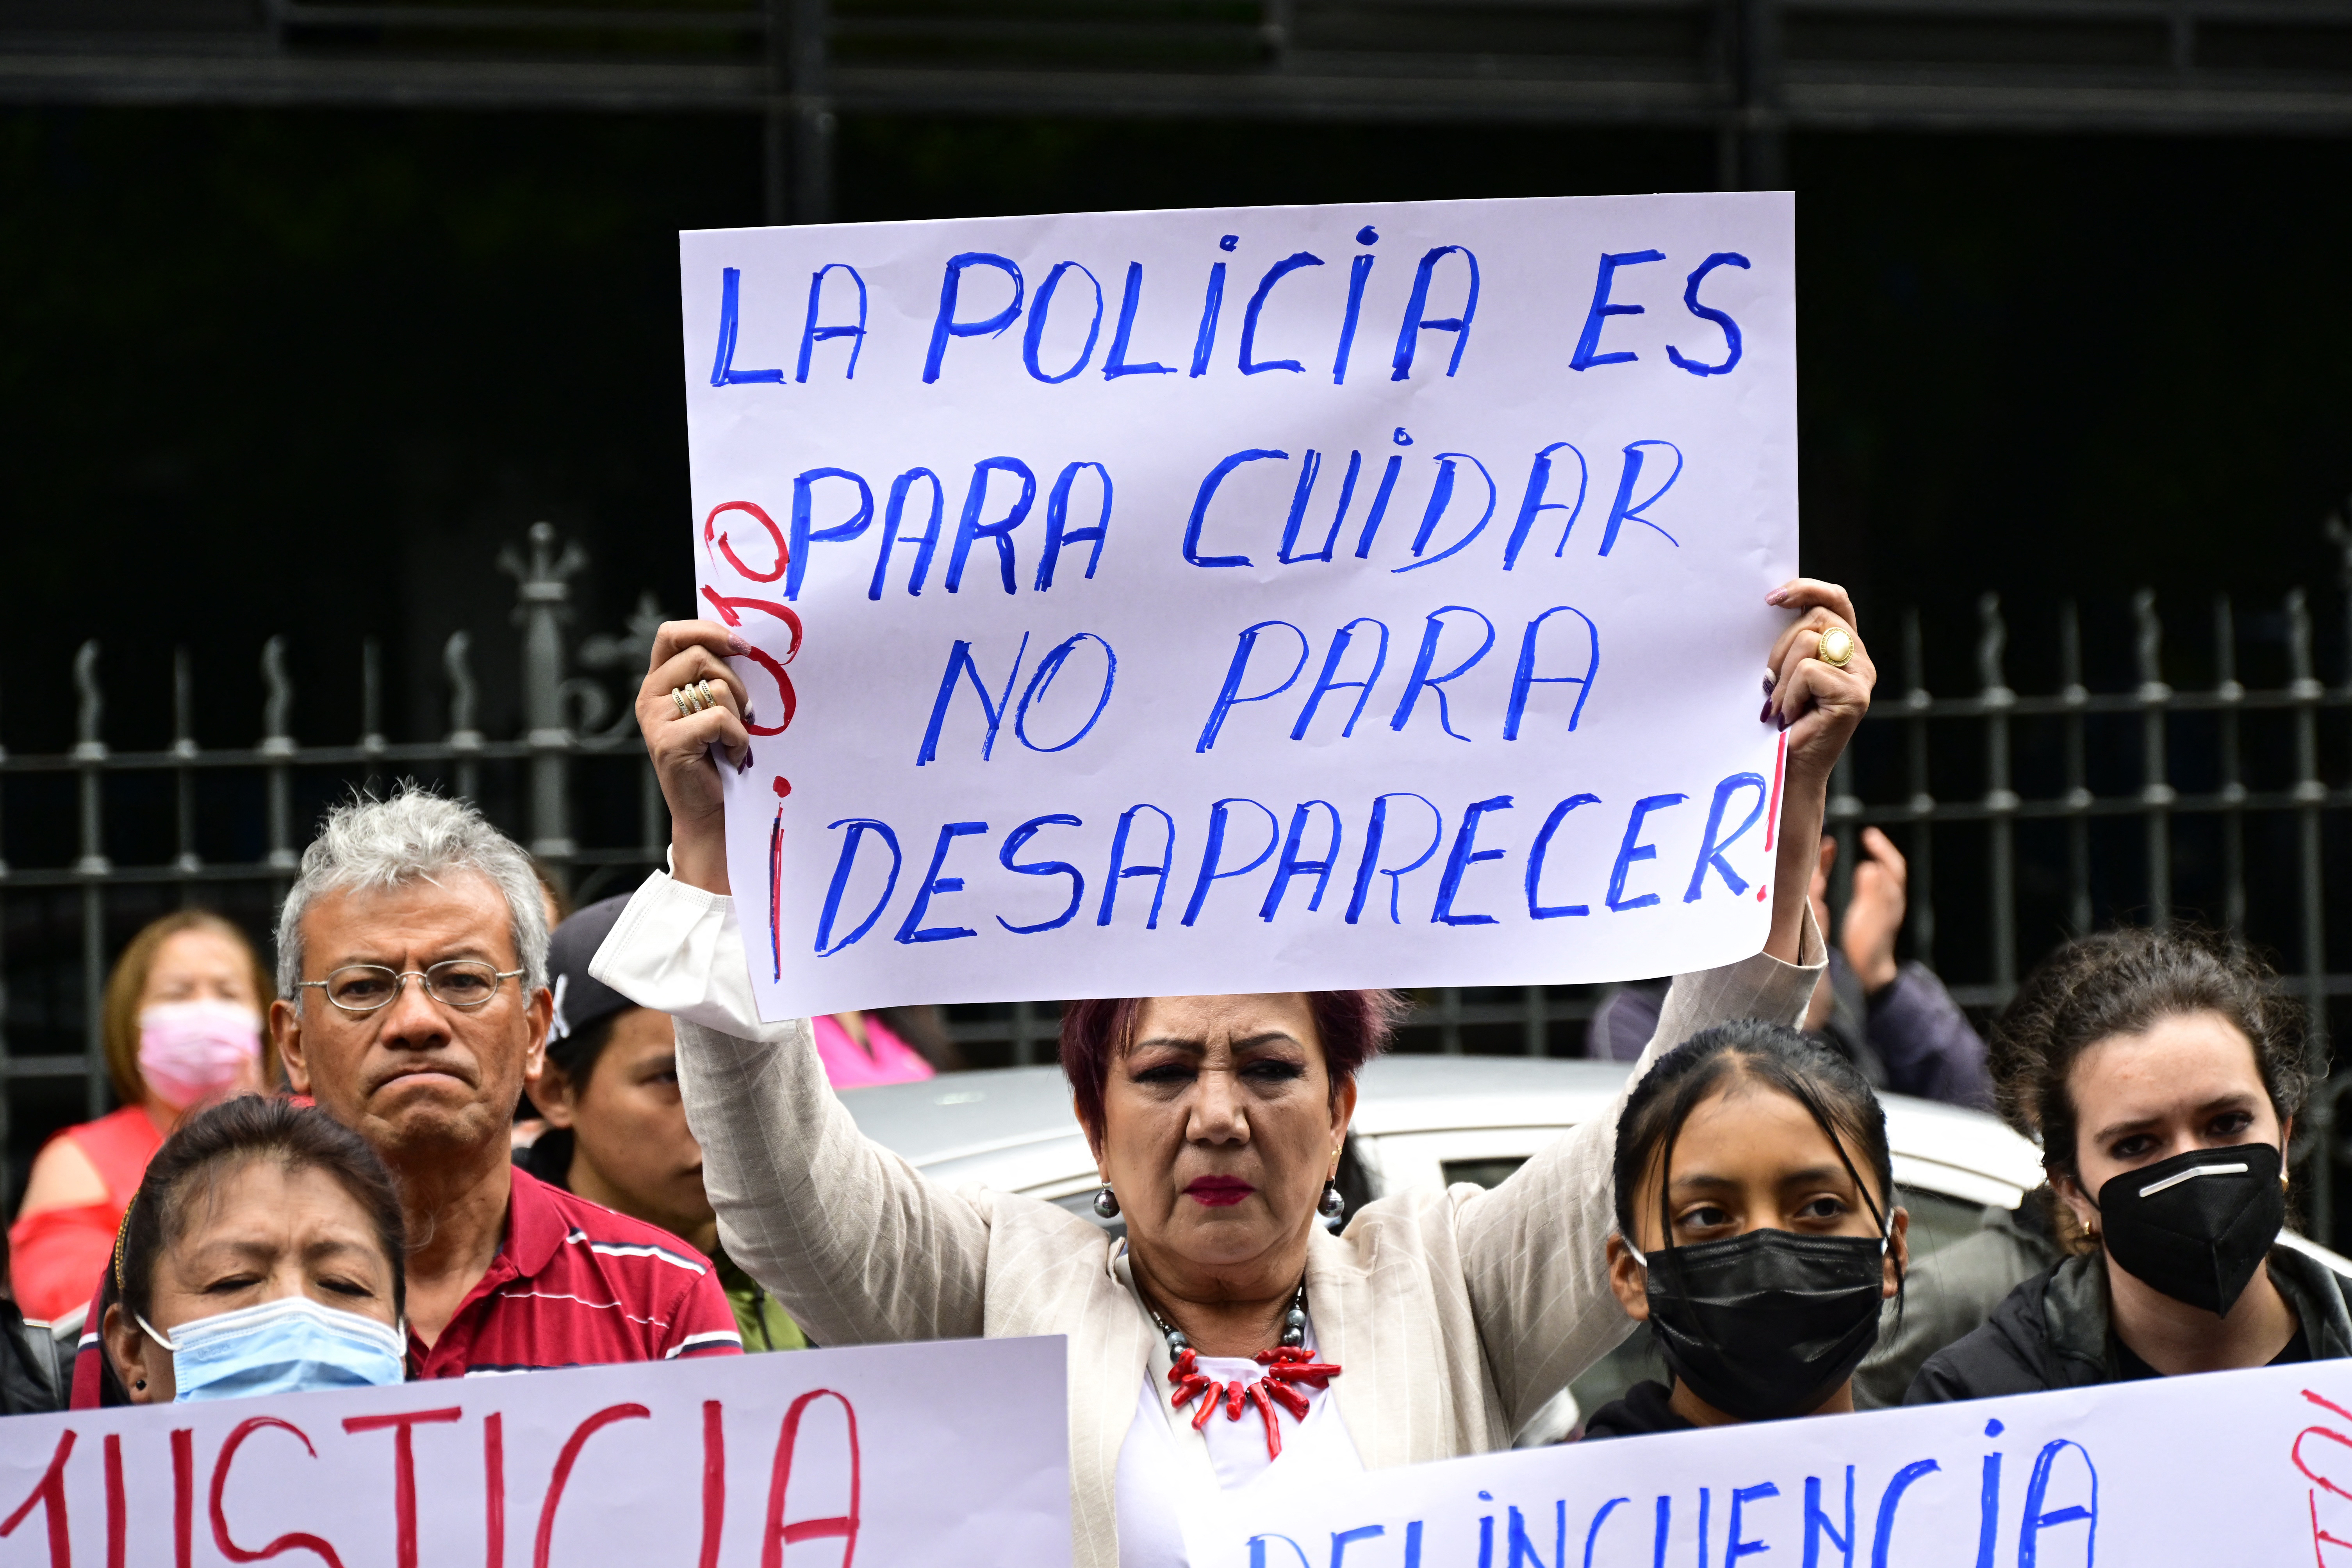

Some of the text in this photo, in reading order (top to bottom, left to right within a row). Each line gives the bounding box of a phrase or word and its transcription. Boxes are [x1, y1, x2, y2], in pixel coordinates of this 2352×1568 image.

[710, 264, 868, 387] LA
[1569, 250, 1751, 377] ES
[783, 427, 1683, 601] PARA CUIDAR
[916, 606, 1600, 766] NO PARA
